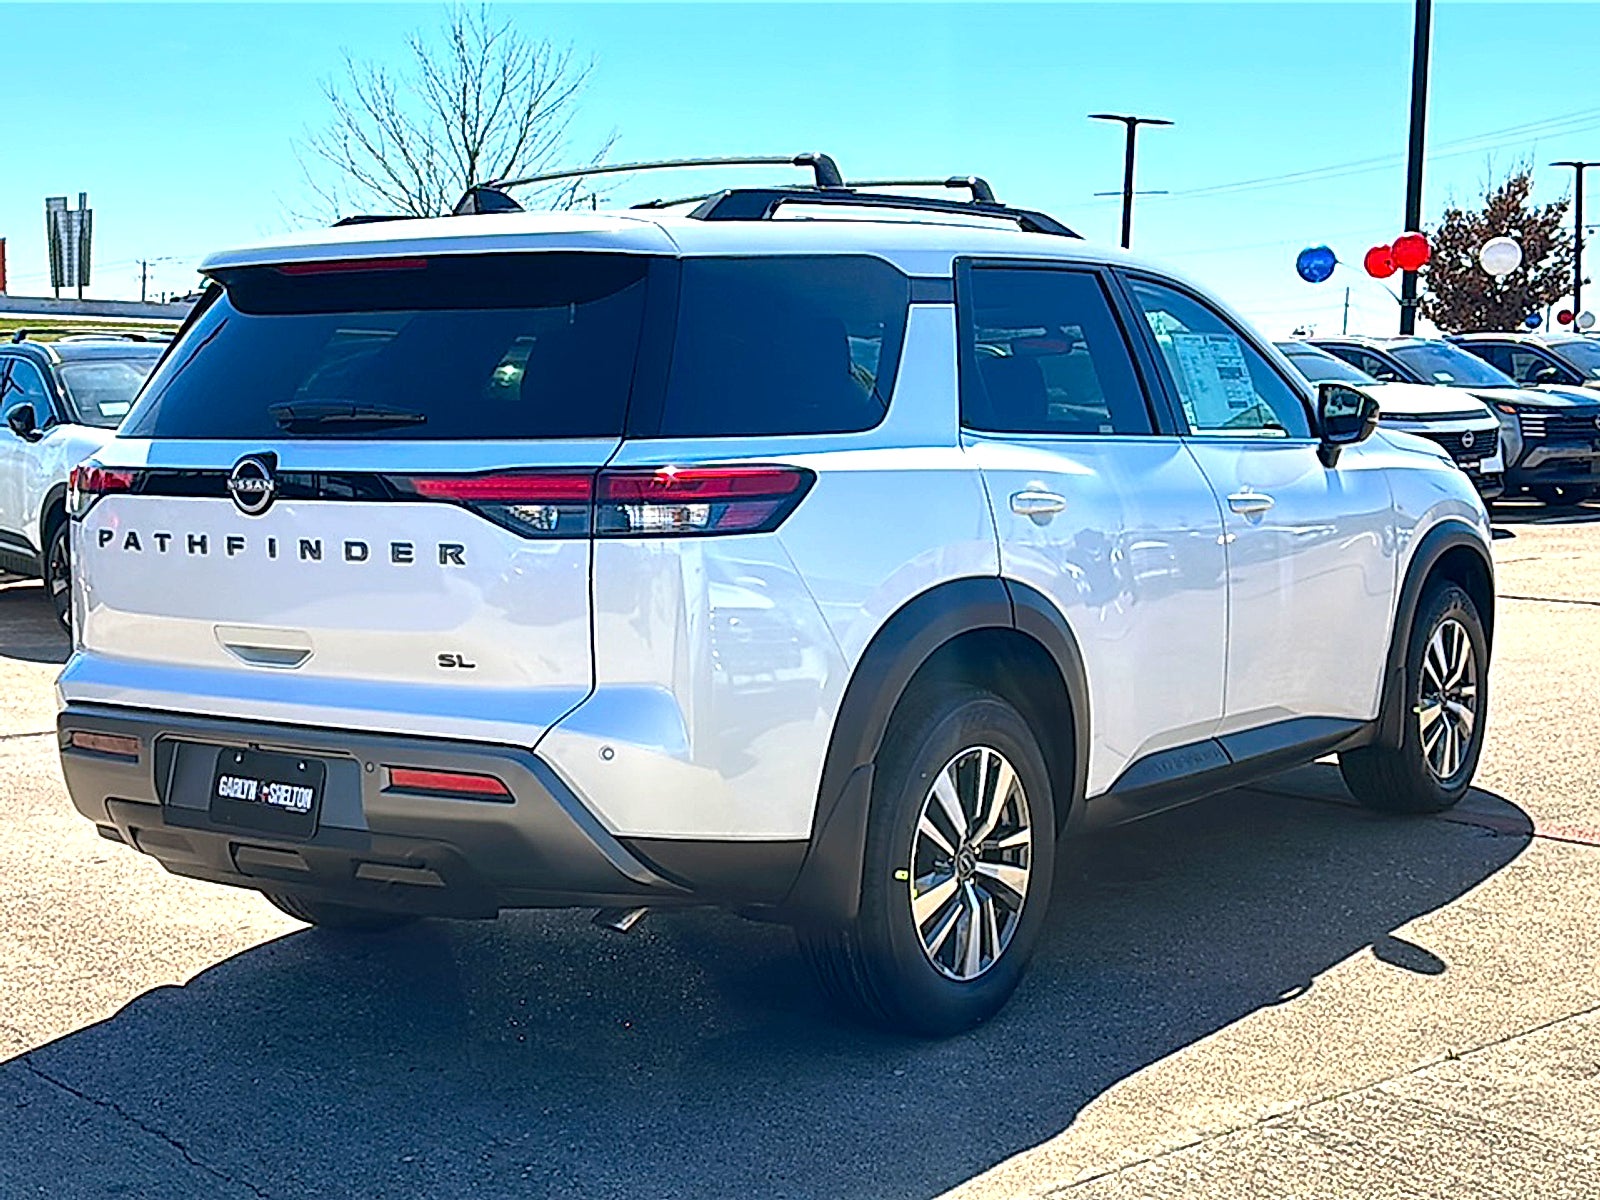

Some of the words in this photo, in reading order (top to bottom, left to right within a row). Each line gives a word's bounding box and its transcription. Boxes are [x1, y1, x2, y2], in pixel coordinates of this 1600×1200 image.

[227, 479, 274, 491] NISSAN
[98, 528, 466, 566] PATHFINDER
[438, 653, 476, 669] SL
[218, 776, 258, 801] GARLYN
[268, 783, 313, 810] SHELTON
